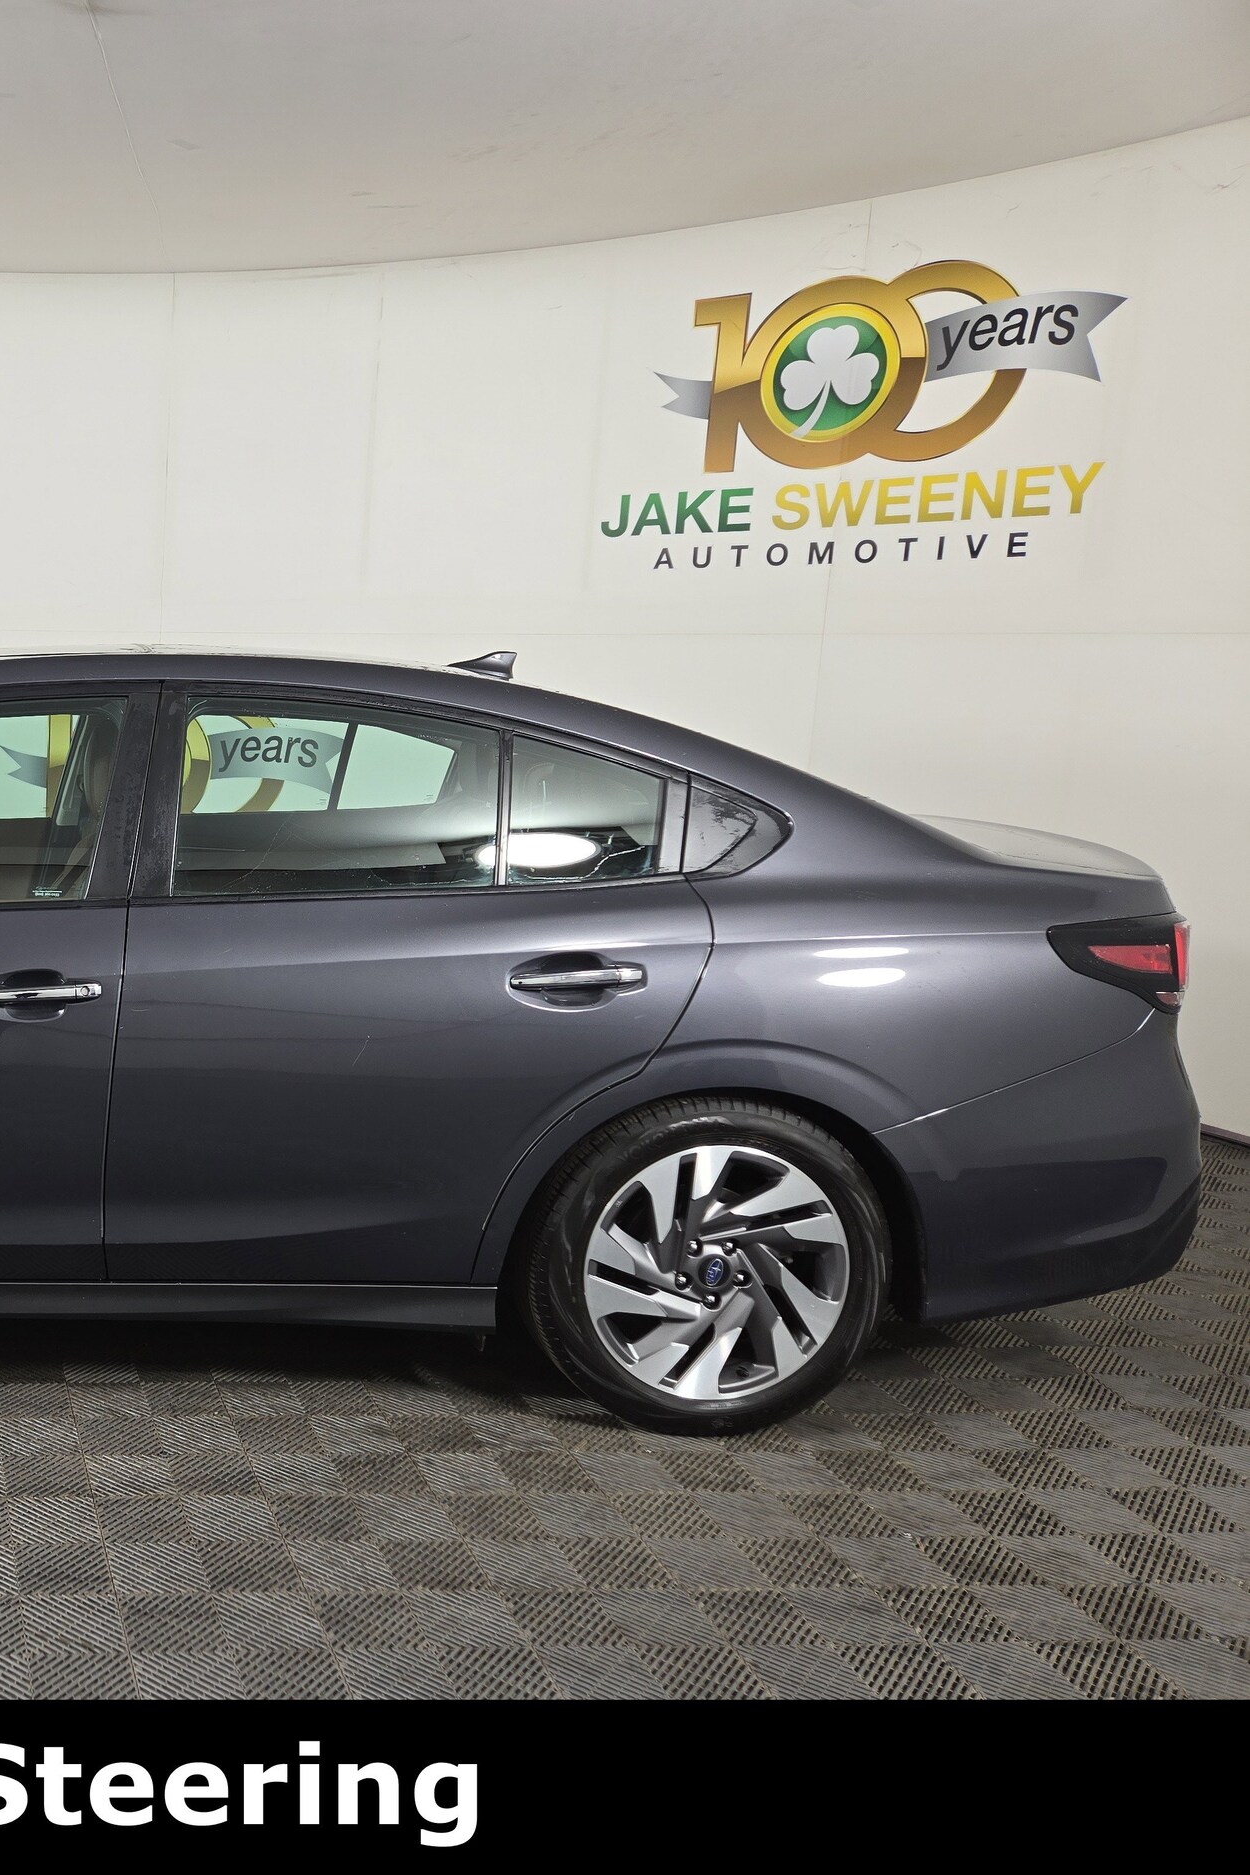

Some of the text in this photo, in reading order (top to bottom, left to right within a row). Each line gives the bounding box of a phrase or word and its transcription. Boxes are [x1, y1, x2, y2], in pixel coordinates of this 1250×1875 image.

[694, 260, 1079, 474] 100 years
[600, 461, 1105, 538] JAKE SWEENEY
[653, 532, 1029, 571] AUTOMOTIVE
[218, 734, 319, 772] years
